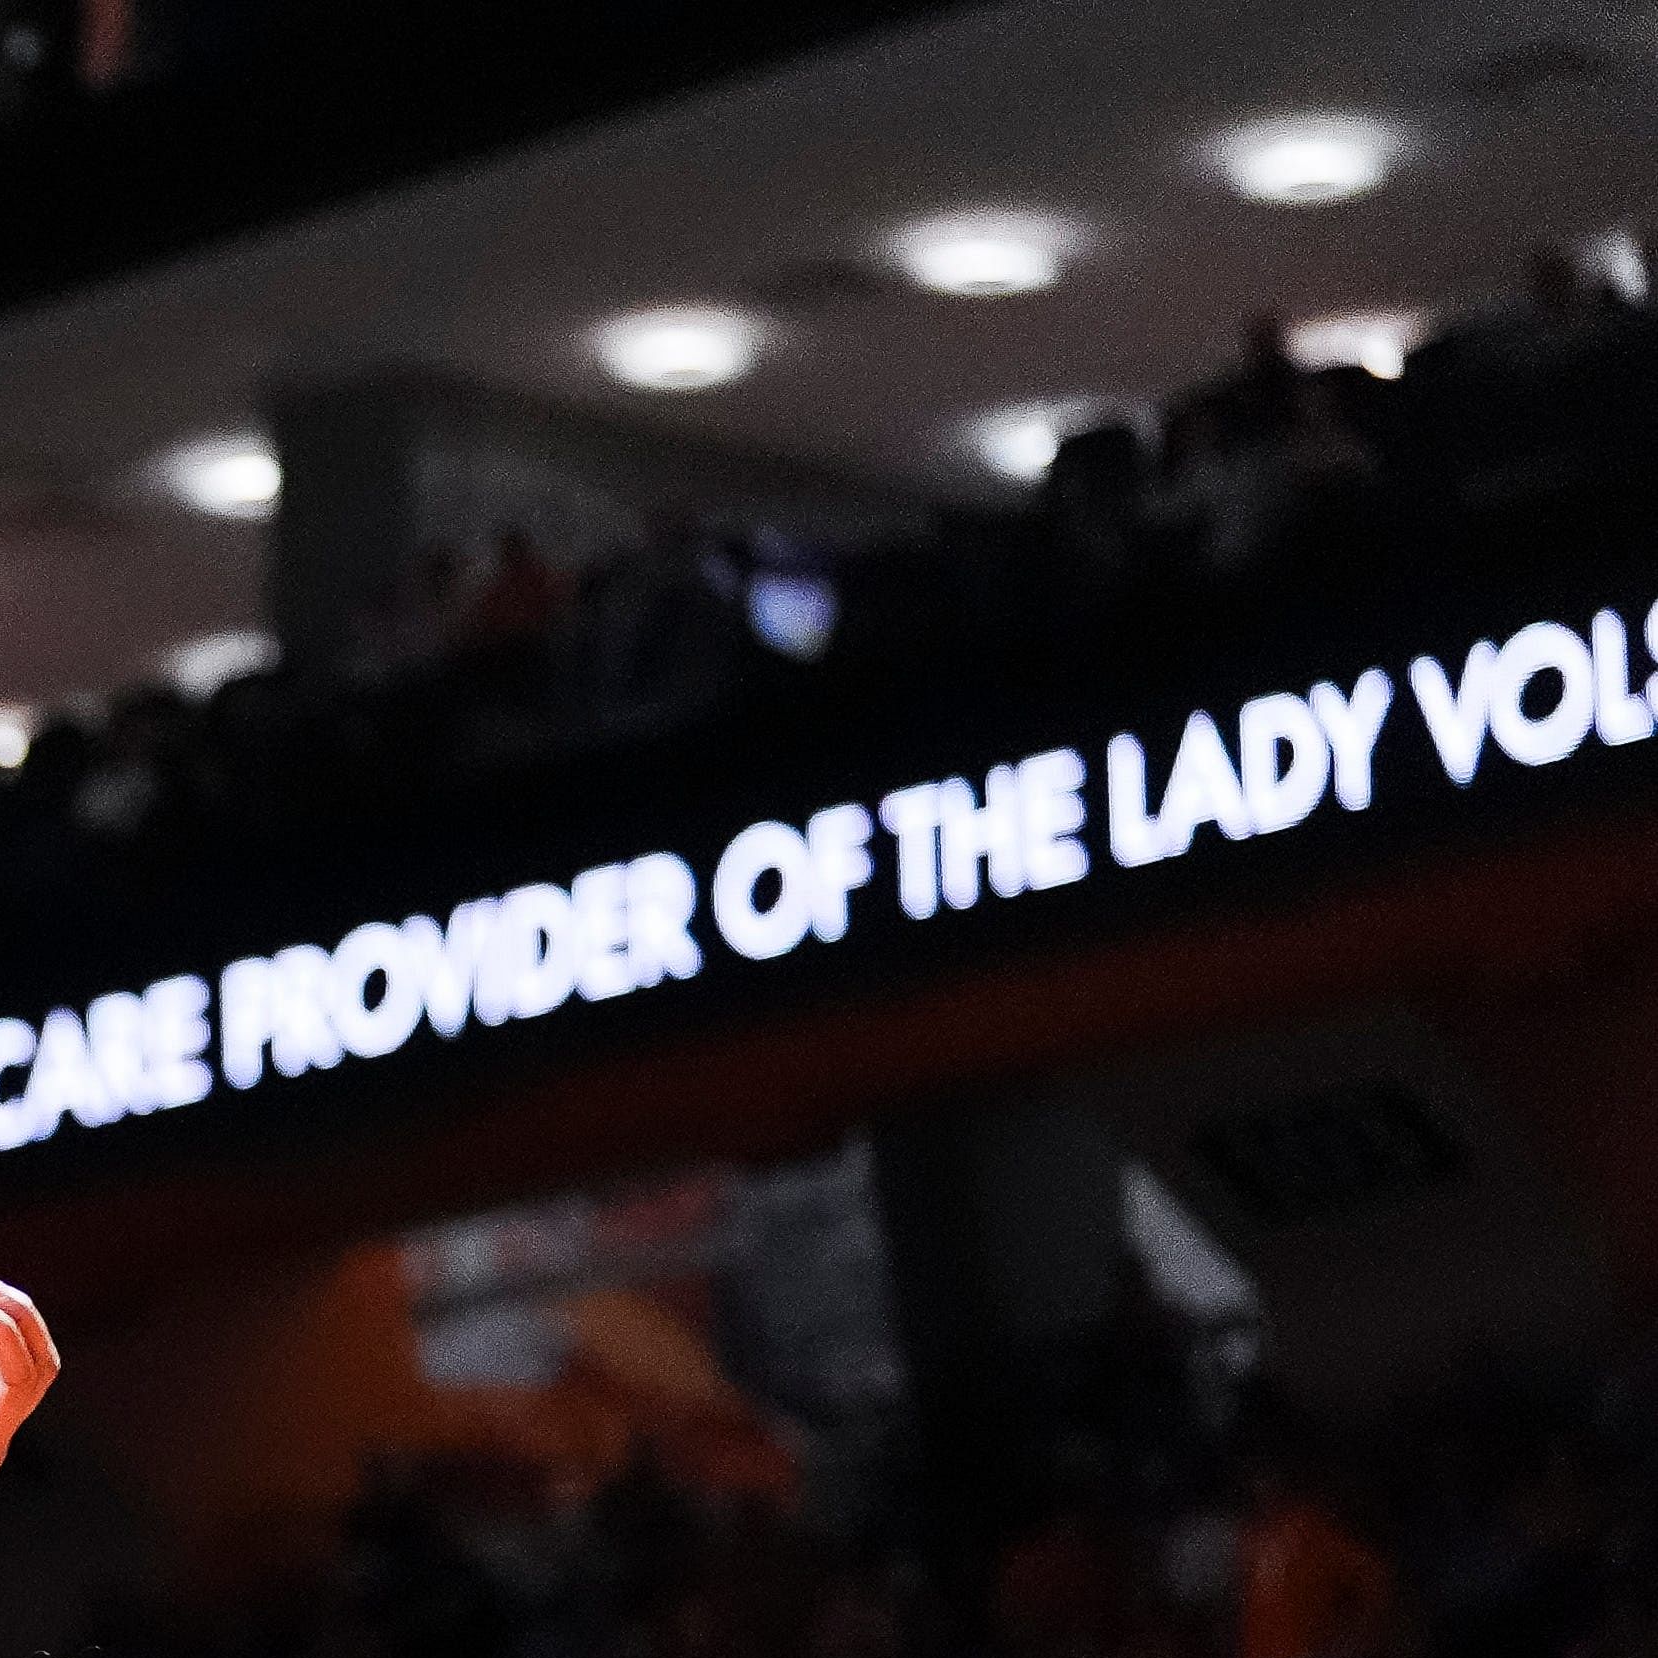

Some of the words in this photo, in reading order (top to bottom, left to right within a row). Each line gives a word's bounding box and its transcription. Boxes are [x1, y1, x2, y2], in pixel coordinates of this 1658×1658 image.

[220, 850, 702, 1090] PROVIDER
[712, 802, 874, 960] OF
[879, 745, 1089, 920] THE
[1106, 666, 1394, 868] LADY
[1407, 596, 1658, 788] VOL
